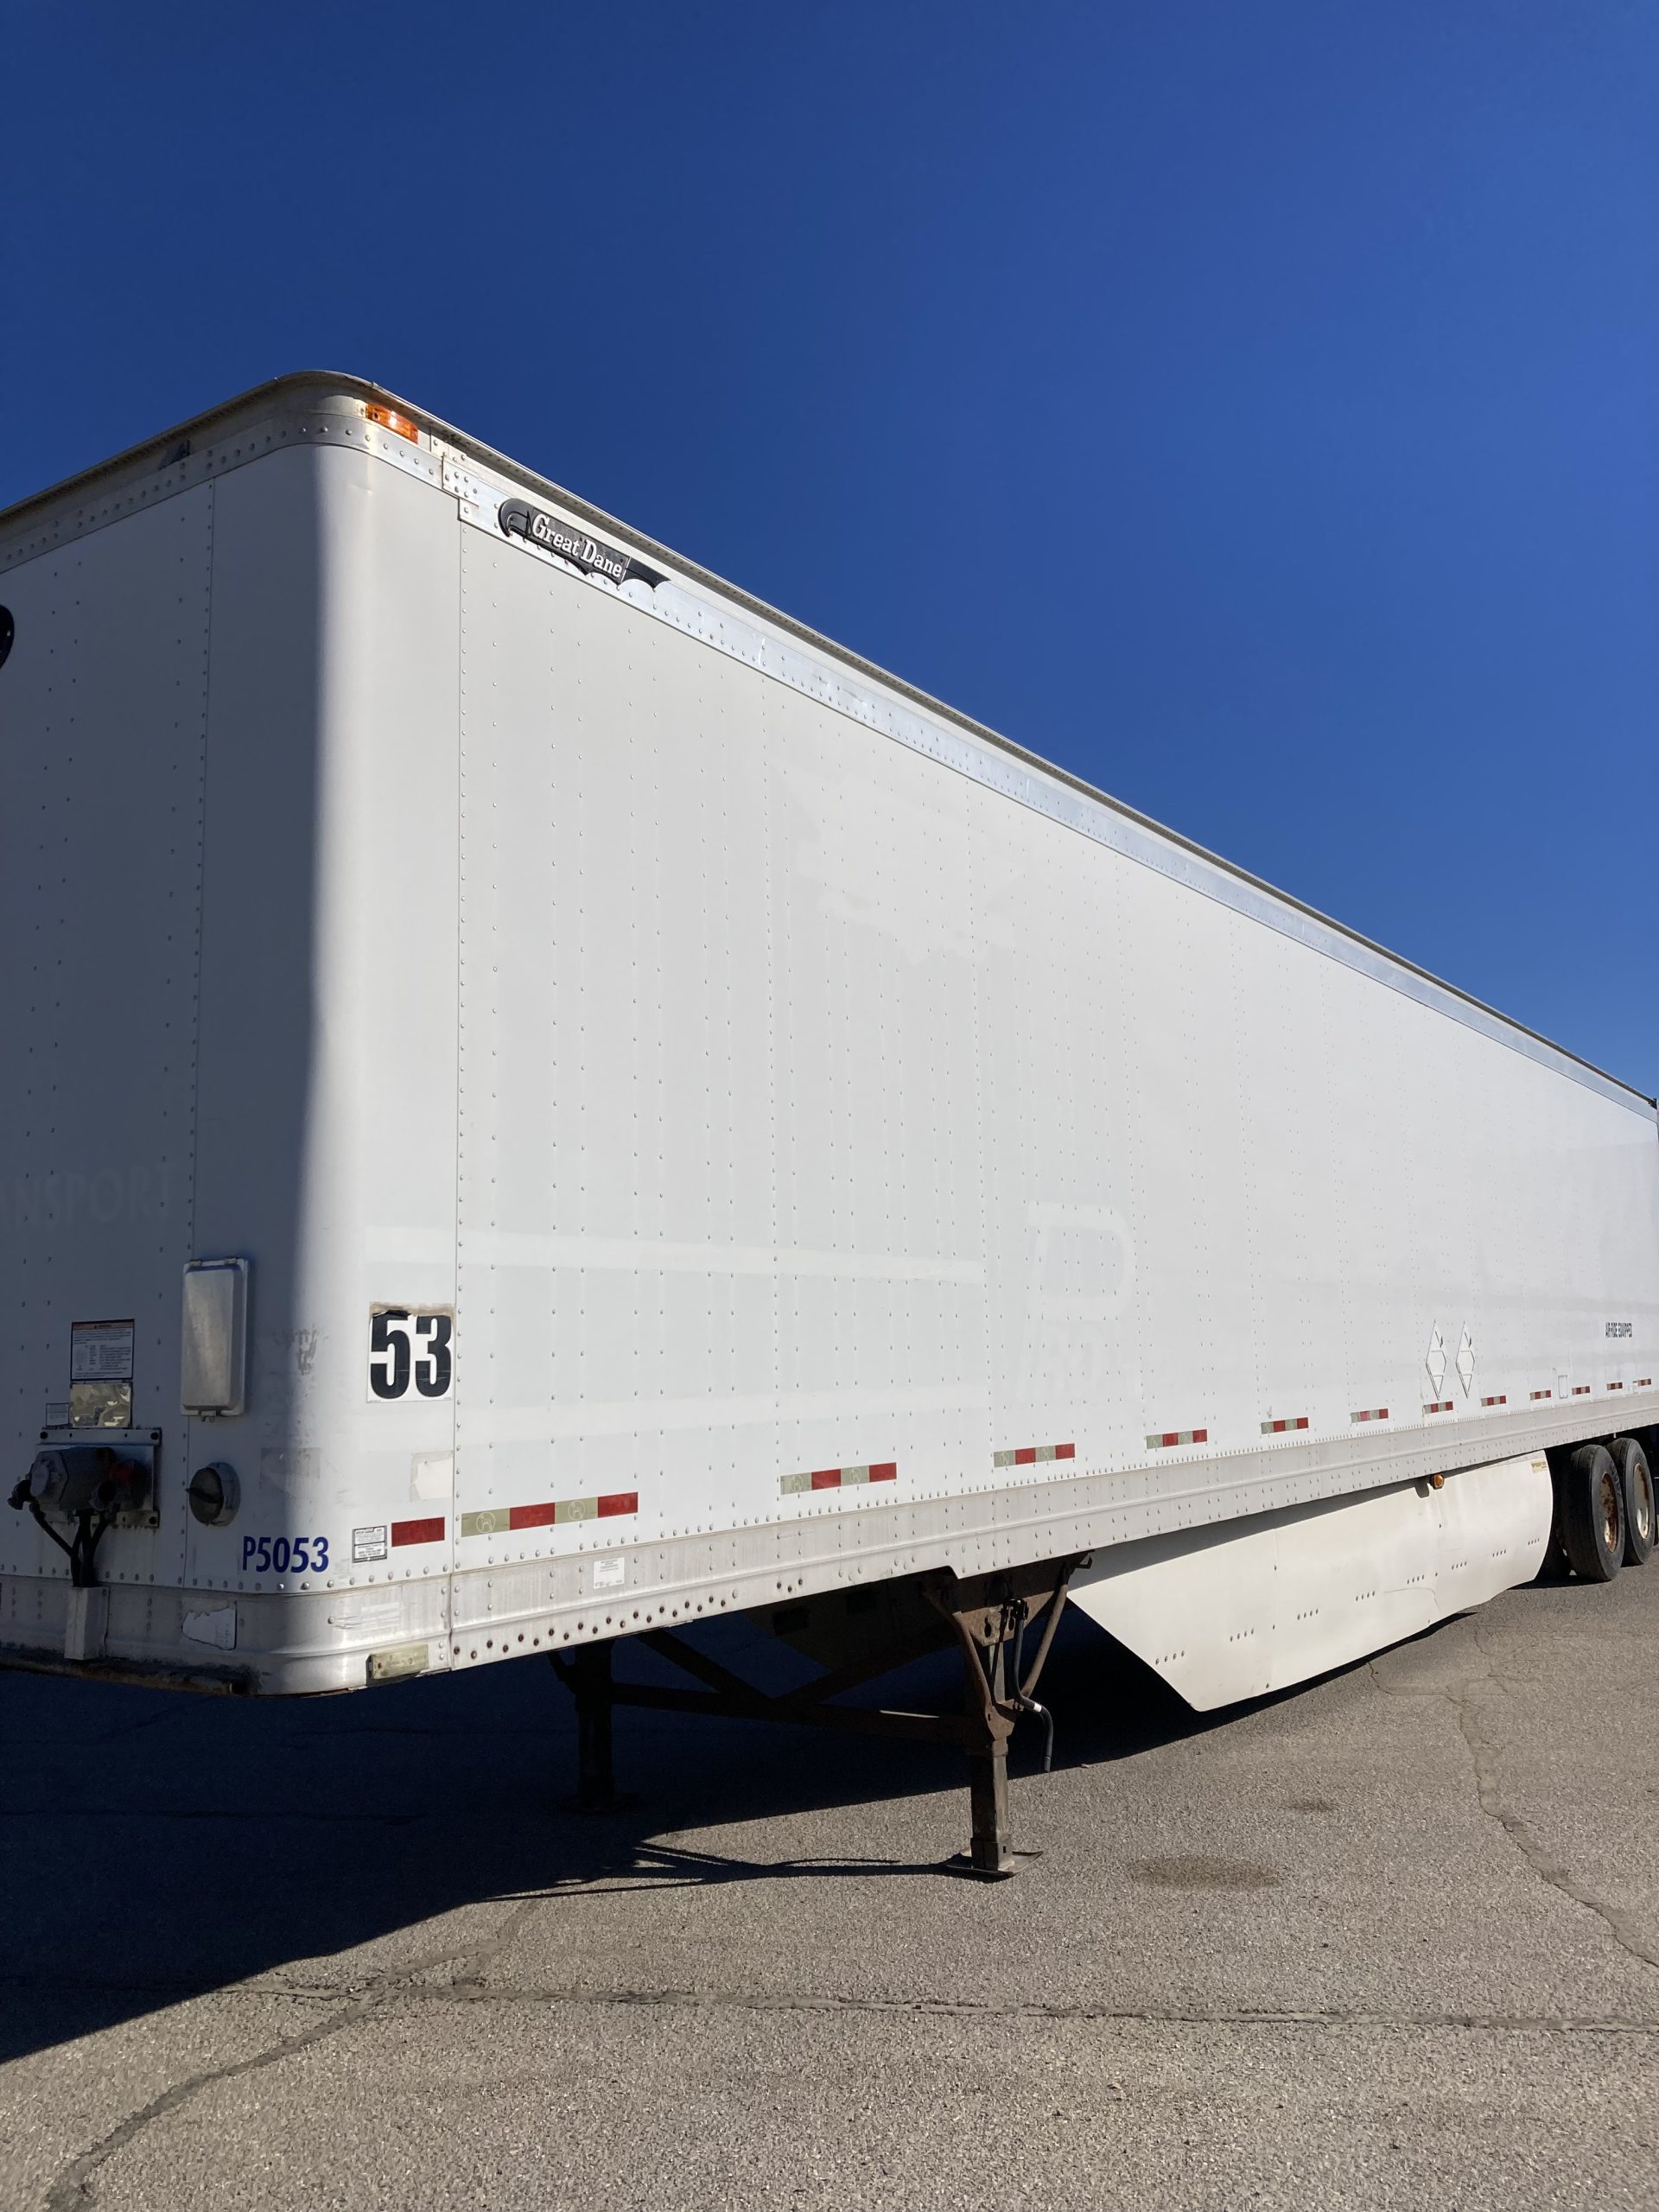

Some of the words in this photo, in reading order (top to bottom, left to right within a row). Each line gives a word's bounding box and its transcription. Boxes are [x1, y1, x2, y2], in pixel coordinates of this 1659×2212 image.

[532, 513, 580, 556] Great
[581, 538, 622, 578] Dane
[371, 1310, 451, 1399] 53
[243, 1535, 328, 1573] P5053
